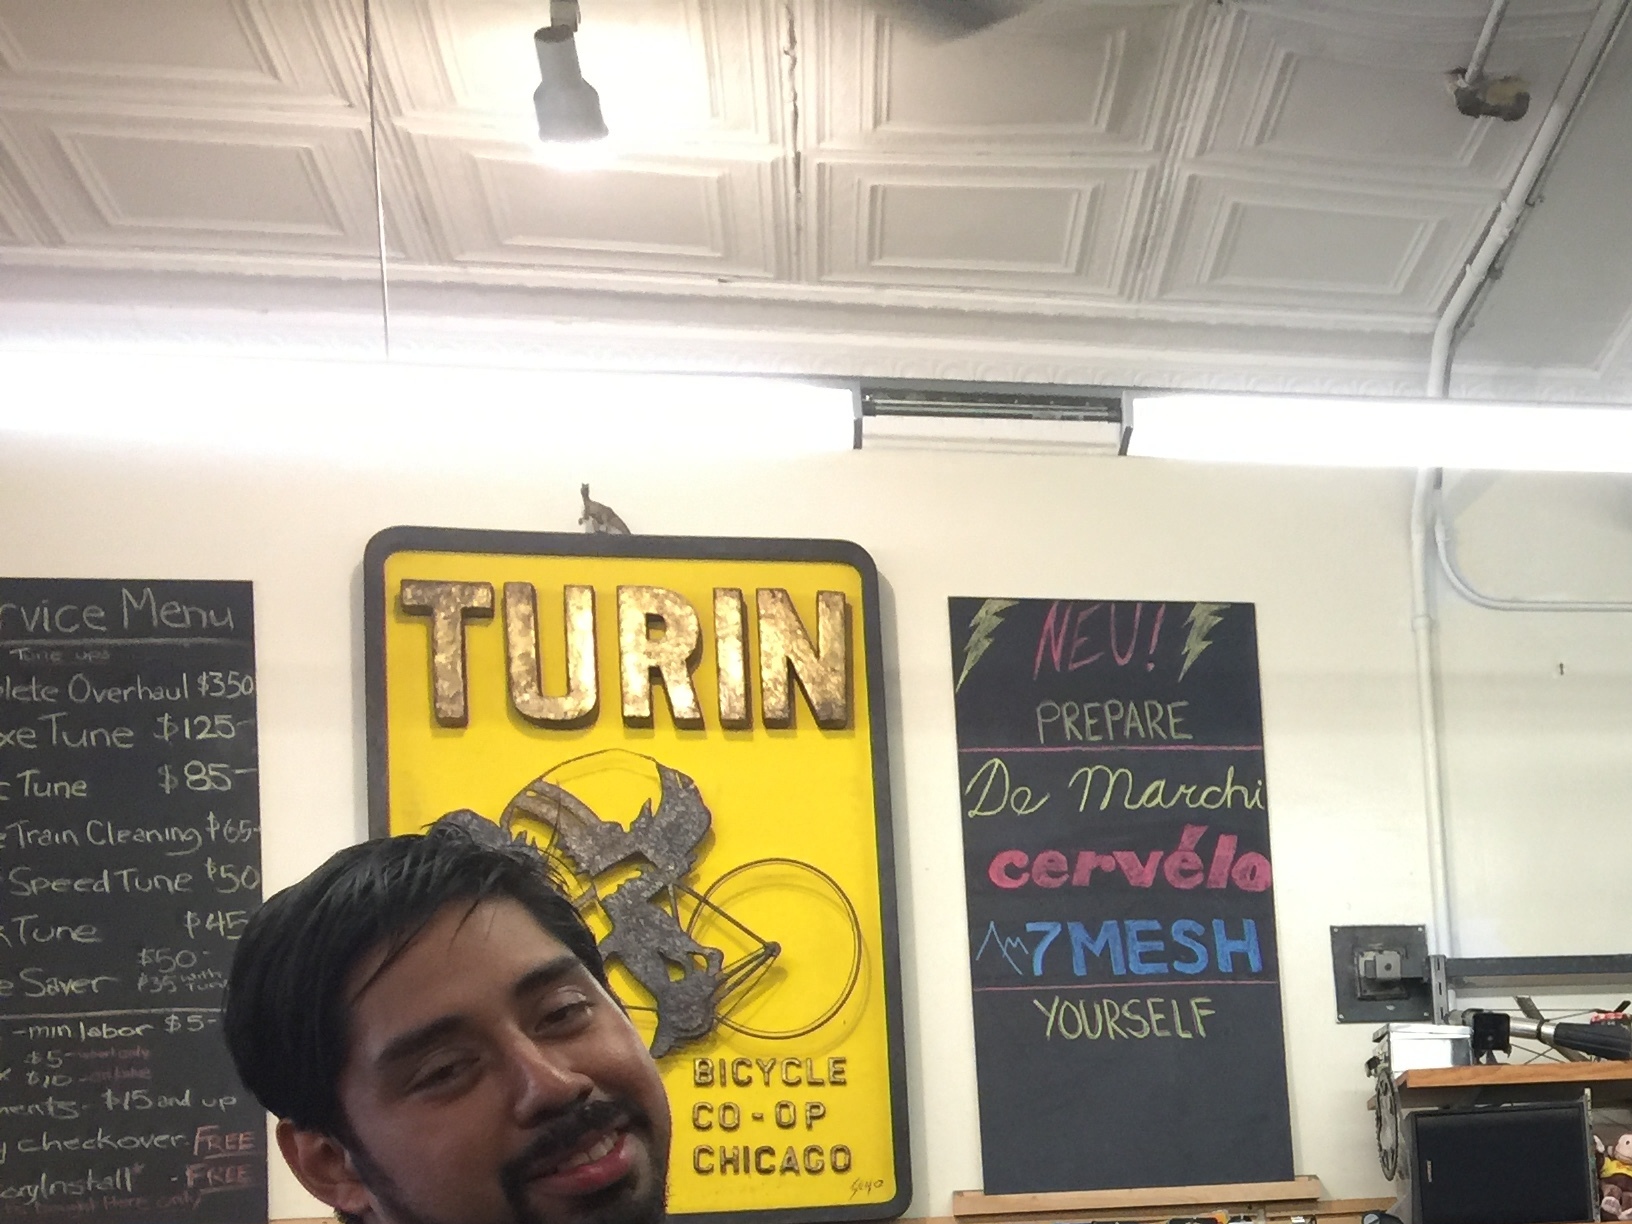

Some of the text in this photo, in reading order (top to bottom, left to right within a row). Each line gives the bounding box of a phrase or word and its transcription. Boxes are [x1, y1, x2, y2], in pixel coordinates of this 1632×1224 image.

[121, 587, 234, 632] Menu
[402, 579, 848, 728] TURIN
[1033, 602, 1166, 680] NEU!
[68, 673, 189, 702] Overhaul
[197, 671, 253, 699] $350
[38, 711, 134, 749] Tune
[1035, 700, 1194, 744] PREPARE
[16, 768, 87, 799] Tune
[965, 758, 1265, 818] De Marchi
[5, 820, 80, 848] Train
[86, 819, 203, 855] Cleaning
[988, 824, 1273, 892] cervélo
[9, 866, 110, 896] Speed
[114, 868, 192, 893] Tune
[14, 914, 102, 944] Tune
[1025, 919, 1263, 977] 7MESH
[20, 967, 120, 997] Saver
[80, 1021, 155, 1040] labor
[1033, 996, 1216, 1040] YOURSELF
[693, 1056, 848, 1087] BICYCLE
[202, 1096, 237, 1111] up
[18, 1125, 254, 1155] checkover FREE
[186, 1162, 250, 1188] FREE
[692, 1144, 853, 1176] CHICAGO
